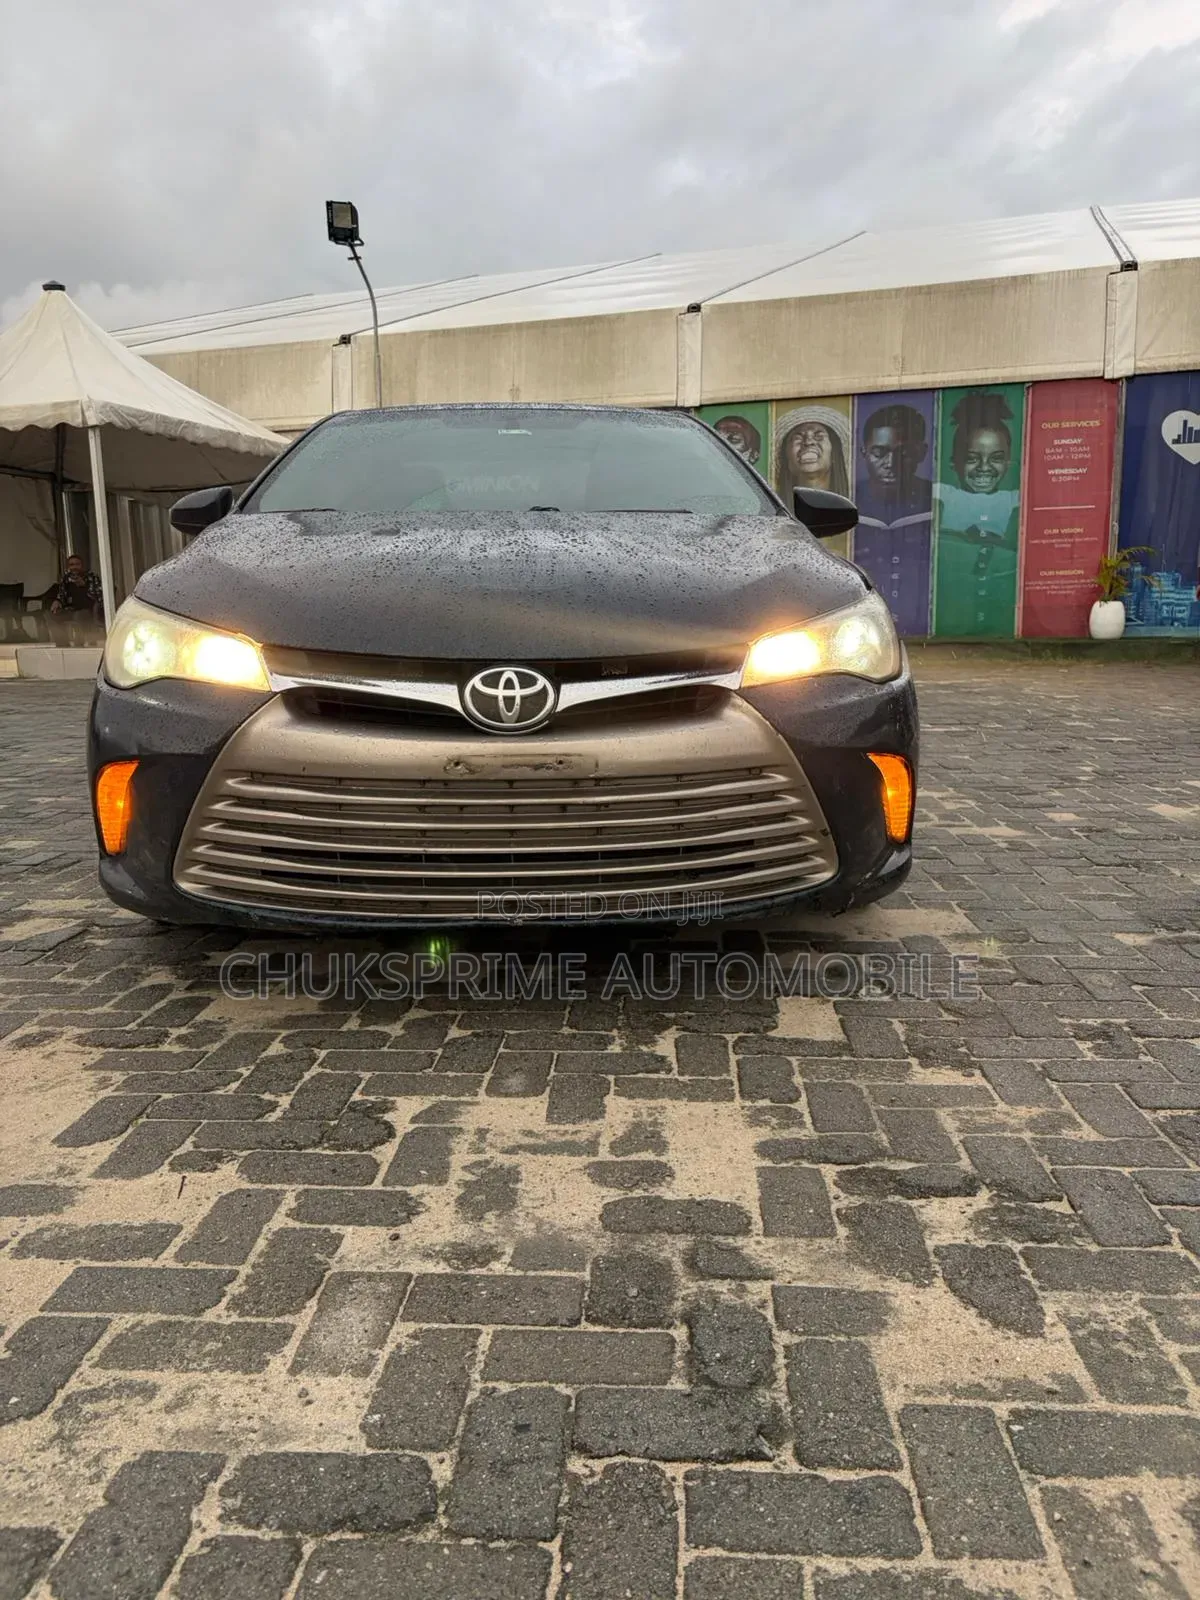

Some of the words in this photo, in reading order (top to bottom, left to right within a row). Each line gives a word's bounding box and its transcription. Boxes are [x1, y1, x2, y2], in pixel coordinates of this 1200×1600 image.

[1041, 422, 1059, 430] OUR
[1060, 420, 1100, 429] SERVICES
[1060, 527, 1084, 535] VISION
[976, 514, 988, 622] WELFARE
[1056, 569, 1084, 577] MISSION
